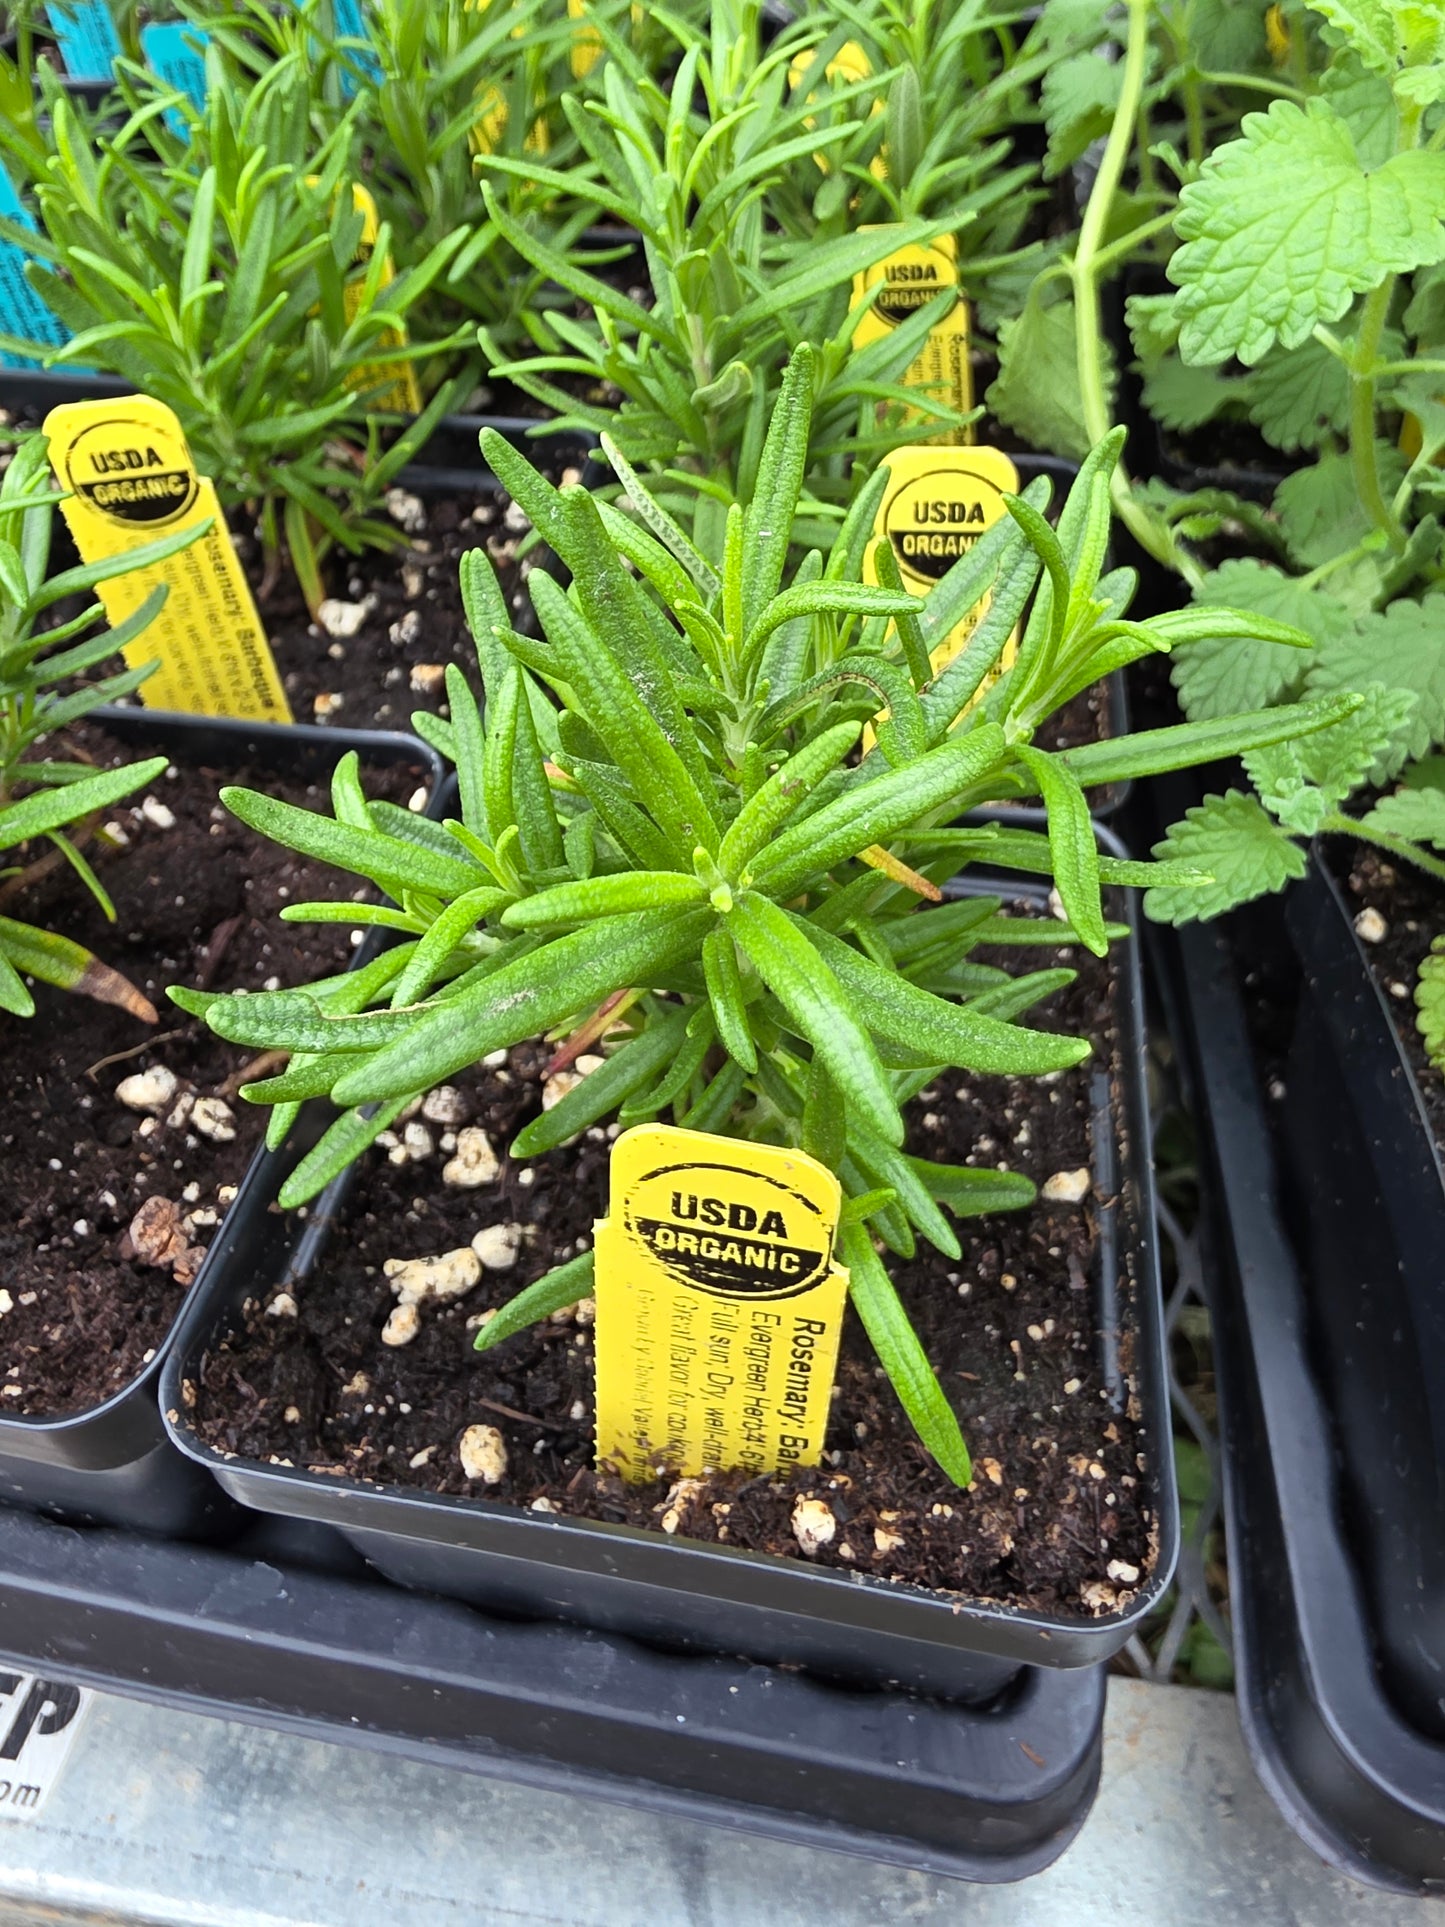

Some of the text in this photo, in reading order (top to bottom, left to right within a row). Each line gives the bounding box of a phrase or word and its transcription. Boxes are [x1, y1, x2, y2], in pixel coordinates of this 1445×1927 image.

[885, 264, 937, 282] USDA
[879, 289, 939, 308] ORGAN
[89, 446, 163, 474] USDA
[92, 475, 187, 505] ORGANIC
[914, 500, 985, 524] USDA
[903, 534, 977, 557] ORGAN
[671, 1190, 788, 1239] USDA
[653, 1226, 801, 1274] ORGANIC
[710, 1300, 740, 1333] Full
[668, 1343, 697, 1387] flavor
[743, 1310, 782, 1392] Evergreen
[699, 1372, 735, 1400] Dry,
[776, 1317, 827, 1429] Rosemary:
[667, 1389, 695, 1411] for
